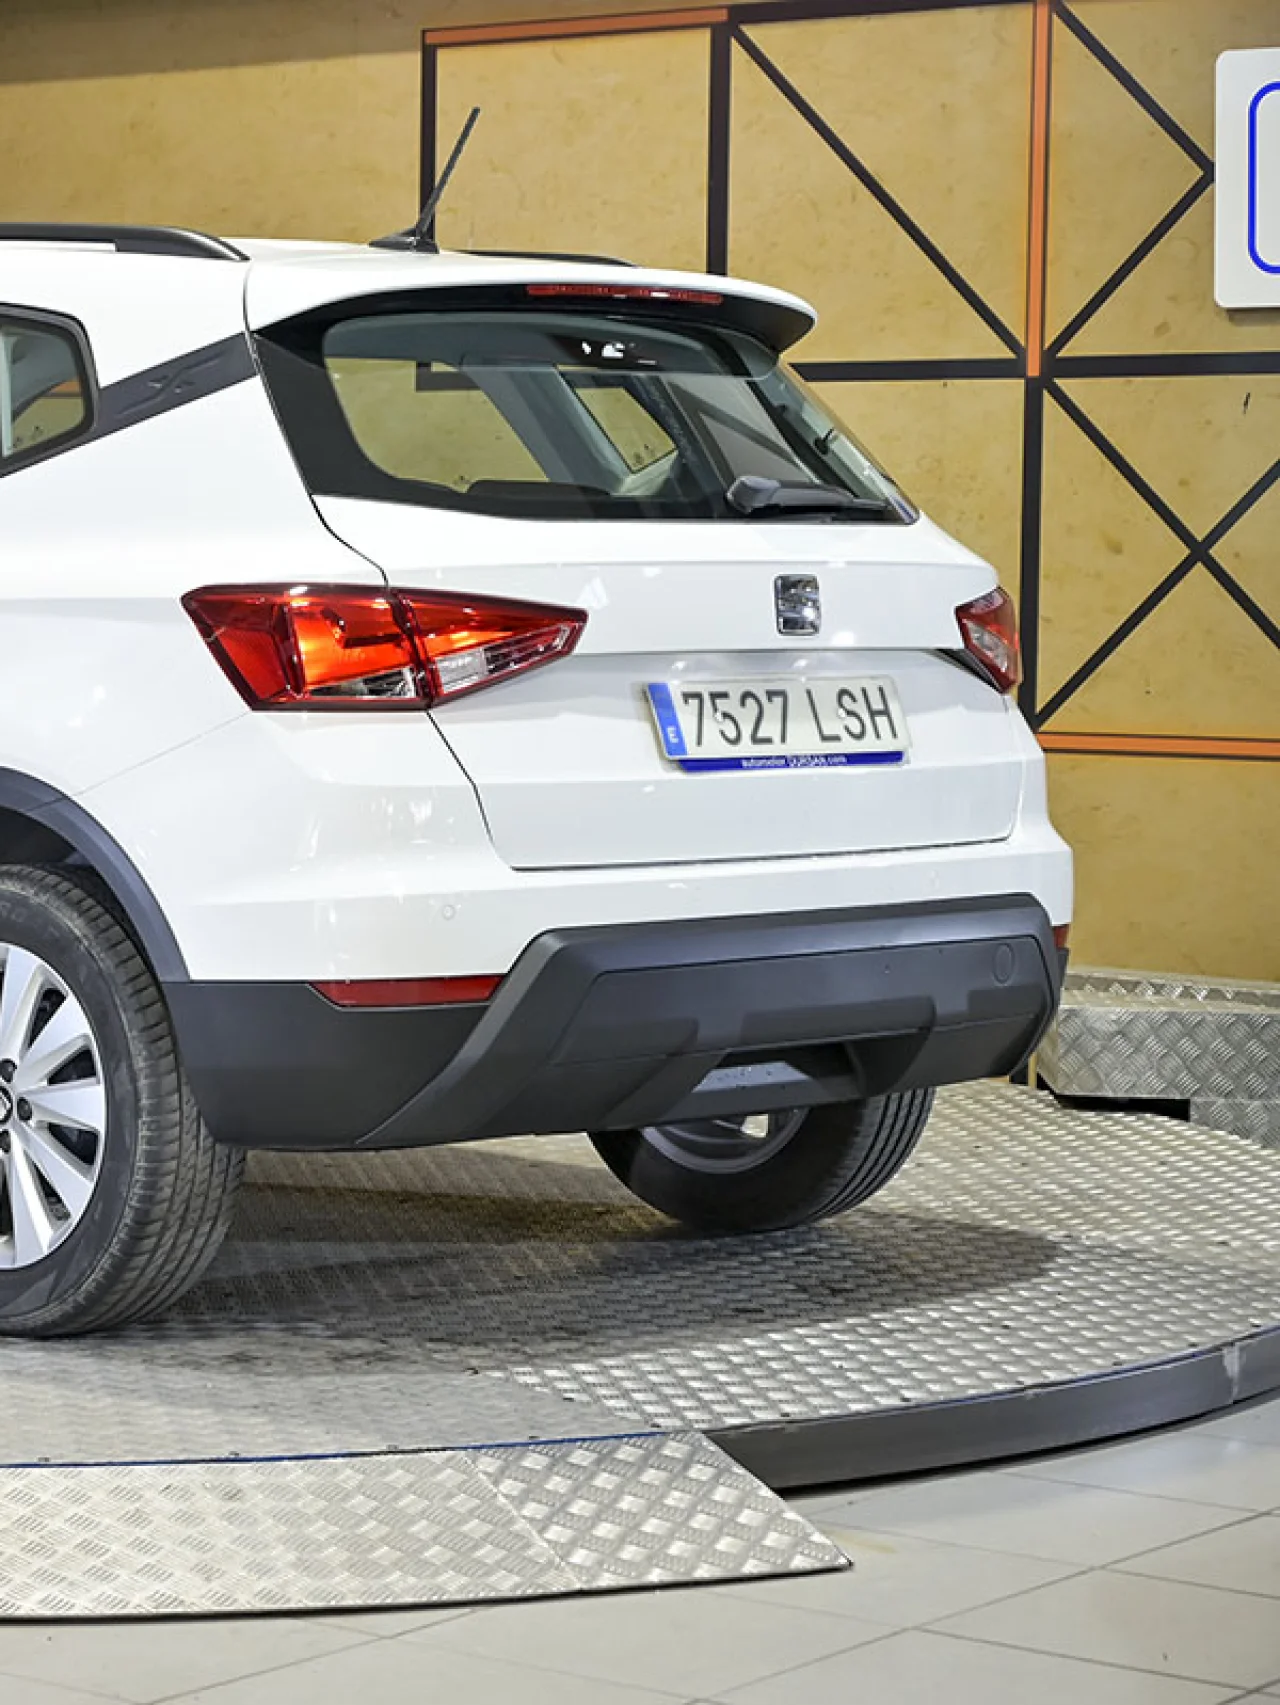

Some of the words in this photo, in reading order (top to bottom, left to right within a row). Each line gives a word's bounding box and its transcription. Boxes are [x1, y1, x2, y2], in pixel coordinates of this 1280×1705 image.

[666, 726, 679, 744] E
[681, 689, 788, 746] 7527
[806, 685, 898, 741] LSH
